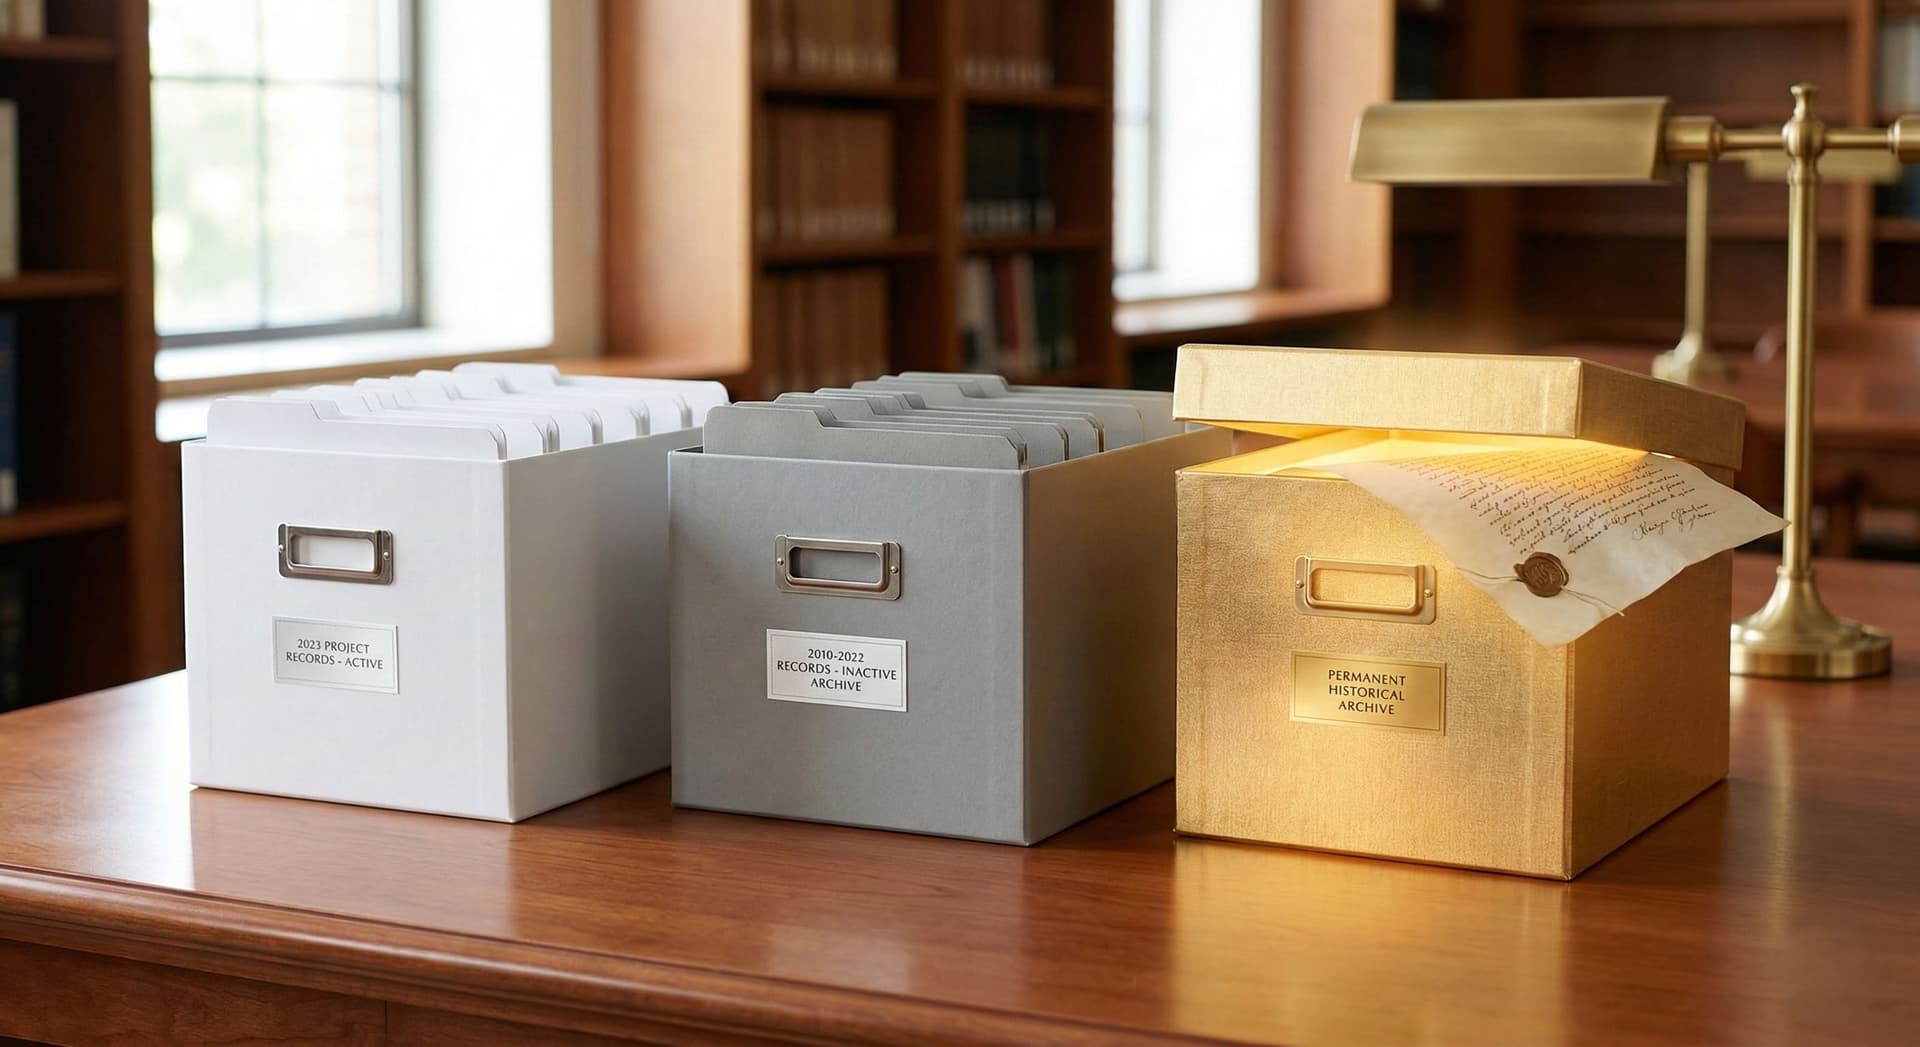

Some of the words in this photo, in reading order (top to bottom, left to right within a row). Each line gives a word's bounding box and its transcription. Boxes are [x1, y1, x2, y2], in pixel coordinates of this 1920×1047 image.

[297, 638, 321, 650] 2023
[324, 640, 370, 654] PROJECT
[286, 651, 335, 665] RECORDS
[345, 657, 383, 670] ACTIVE
[807, 649, 864, 663] 2010-2022
[777, 660, 831, 675] RECORDS
[842, 666, 897, 680] INACTIVE
[1328, 669, 1406, 686] PERMANENT
[811, 678, 862, 692] ARCHIVE
[1328, 685, 1405, 701] HISTORICAL
[1338, 701, 1395, 715] ARCHIVE
